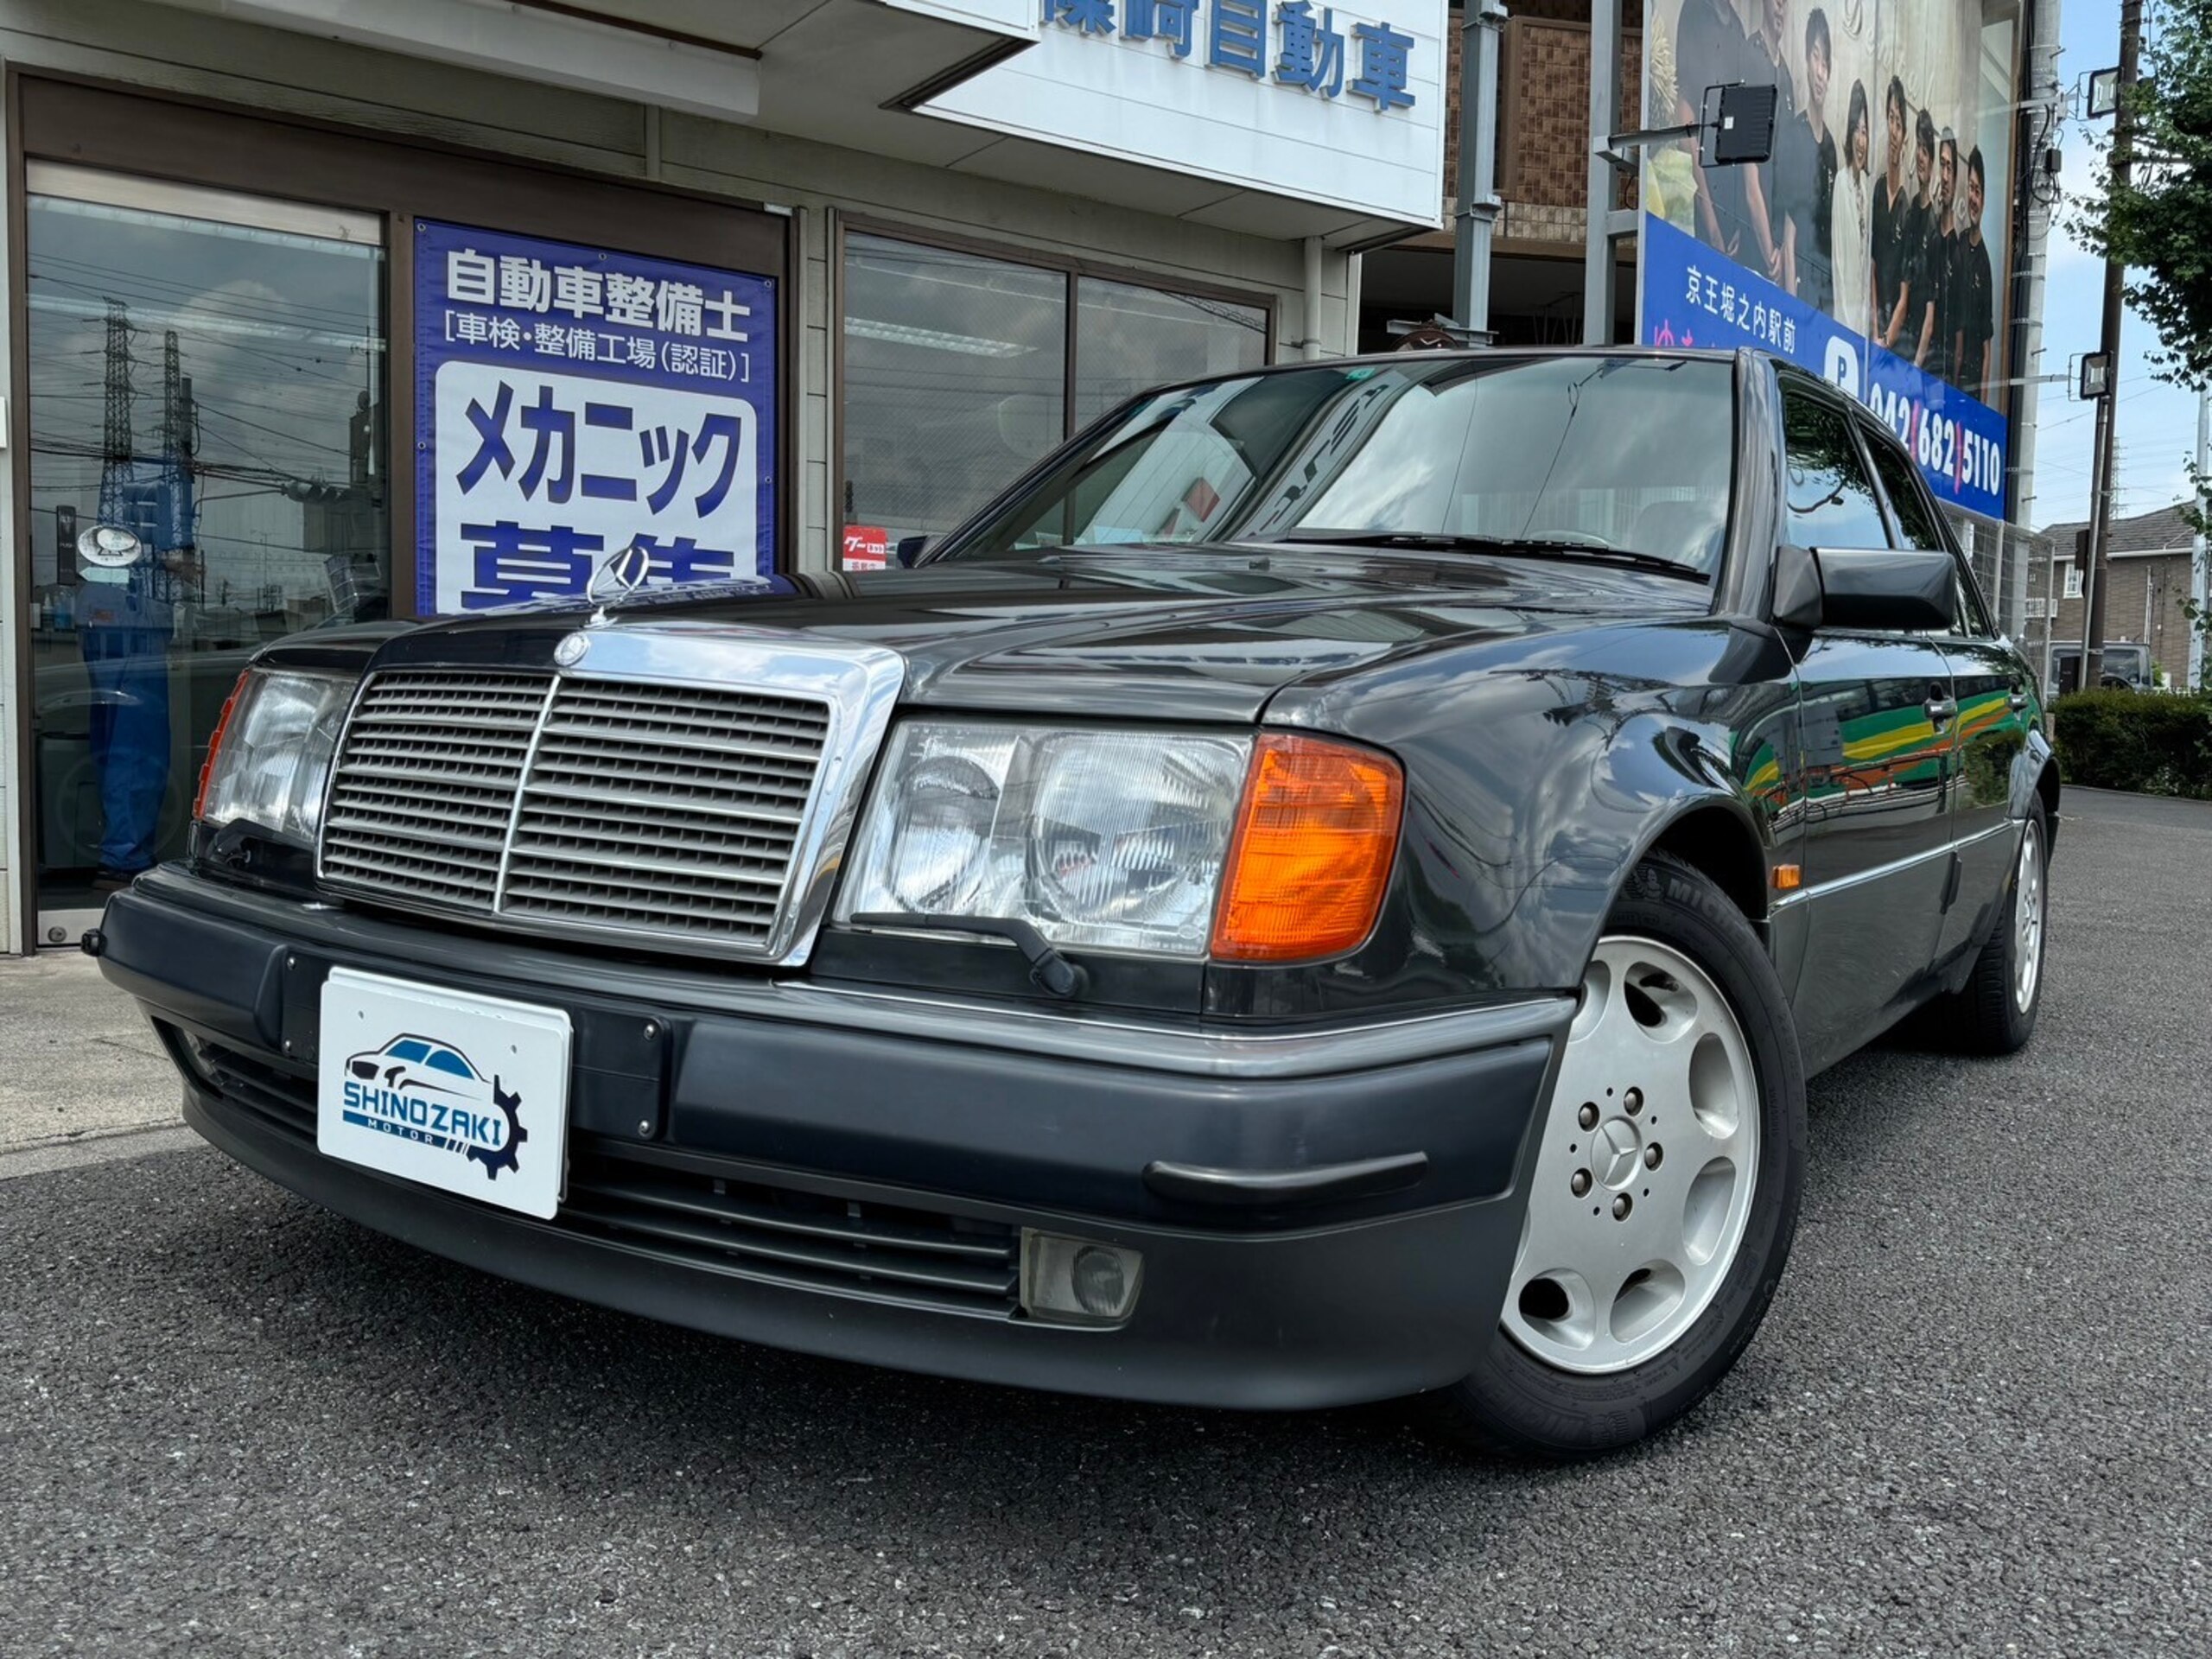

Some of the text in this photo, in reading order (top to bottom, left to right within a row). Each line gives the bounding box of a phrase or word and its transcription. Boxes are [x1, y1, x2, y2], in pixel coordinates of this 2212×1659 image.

[447, 248, 751, 342] 自動車整備士
[1686, 264, 1796, 354] 京王堀之内駅前
[456, 380, 742, 518] メカニック
[343, 1080, 501, 1146] SHINOZAKI
[366, 1117, 434, 1145] MOTOR
